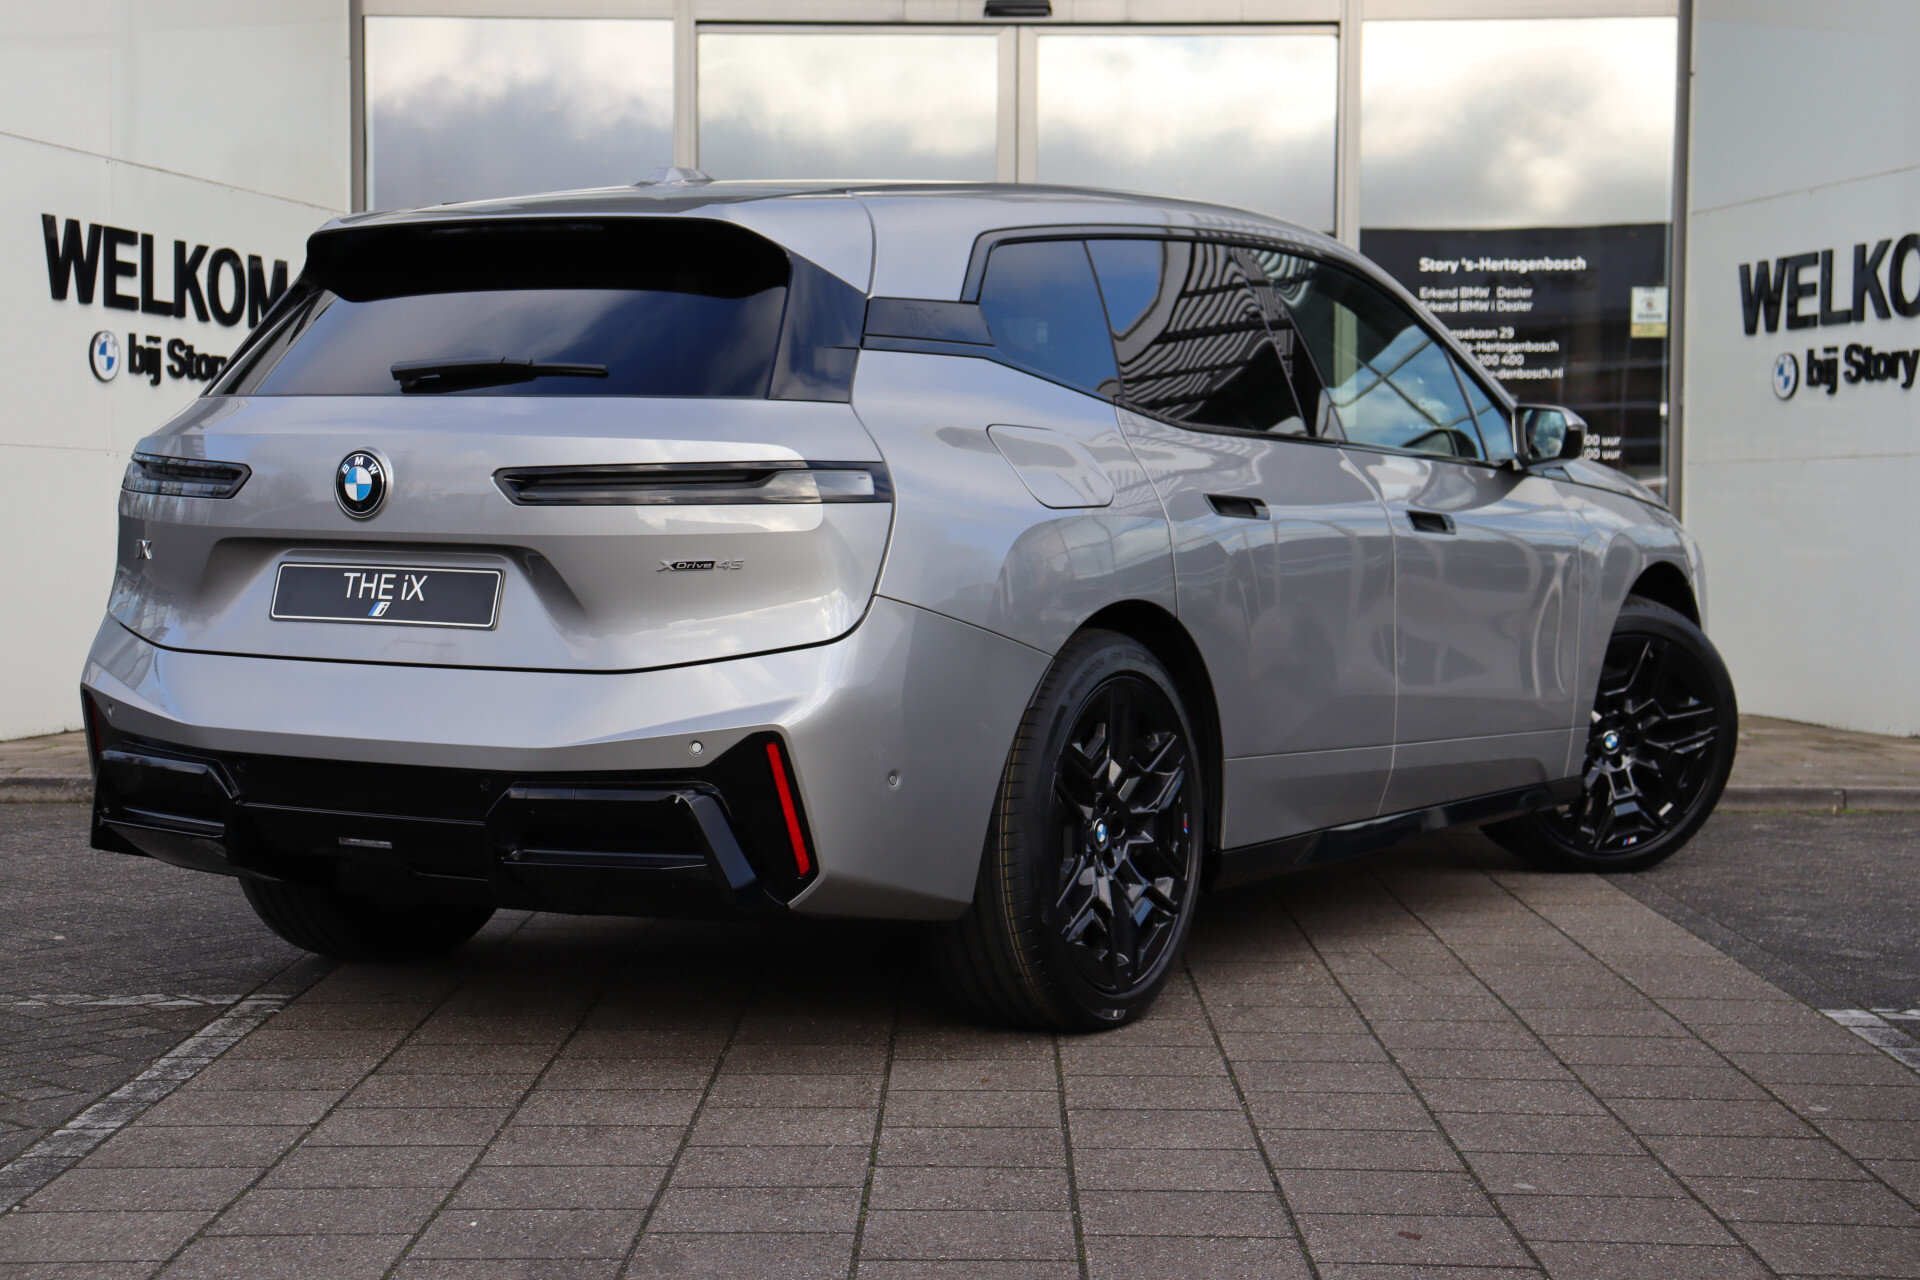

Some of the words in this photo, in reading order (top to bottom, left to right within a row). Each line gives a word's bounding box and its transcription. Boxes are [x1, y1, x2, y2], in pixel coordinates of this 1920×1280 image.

[41, 213, 288, 329] WELKOM
[1418, 257, 1459, 274] Story
[1461, 256, 1587, 274] 's-Hertogenbosch
[1419, 286, 1458, 299] Erkend
[1459, 286, 1490, 299] BMW
[1496, 286, 1534, 299] Dealer
[1739, 233, 1920, 336] WELKO
[1459, 300, 1489, 313] BMW
[1496, 300, 1534, 312] Dealer
[1499, 326, 1515, 339] 29
[128, 332, 162, 386] bij
[166, 338, 228, 382] Stor
[1501, 353, 1525, 366] 400
[1806, 346, 1838, 395] bij
[1843, 343, 1920, 390] Story
[716, 560, 745, 570] 45
[343, 572, 397, 600] THE
[400, 574, 428, 601] iX
